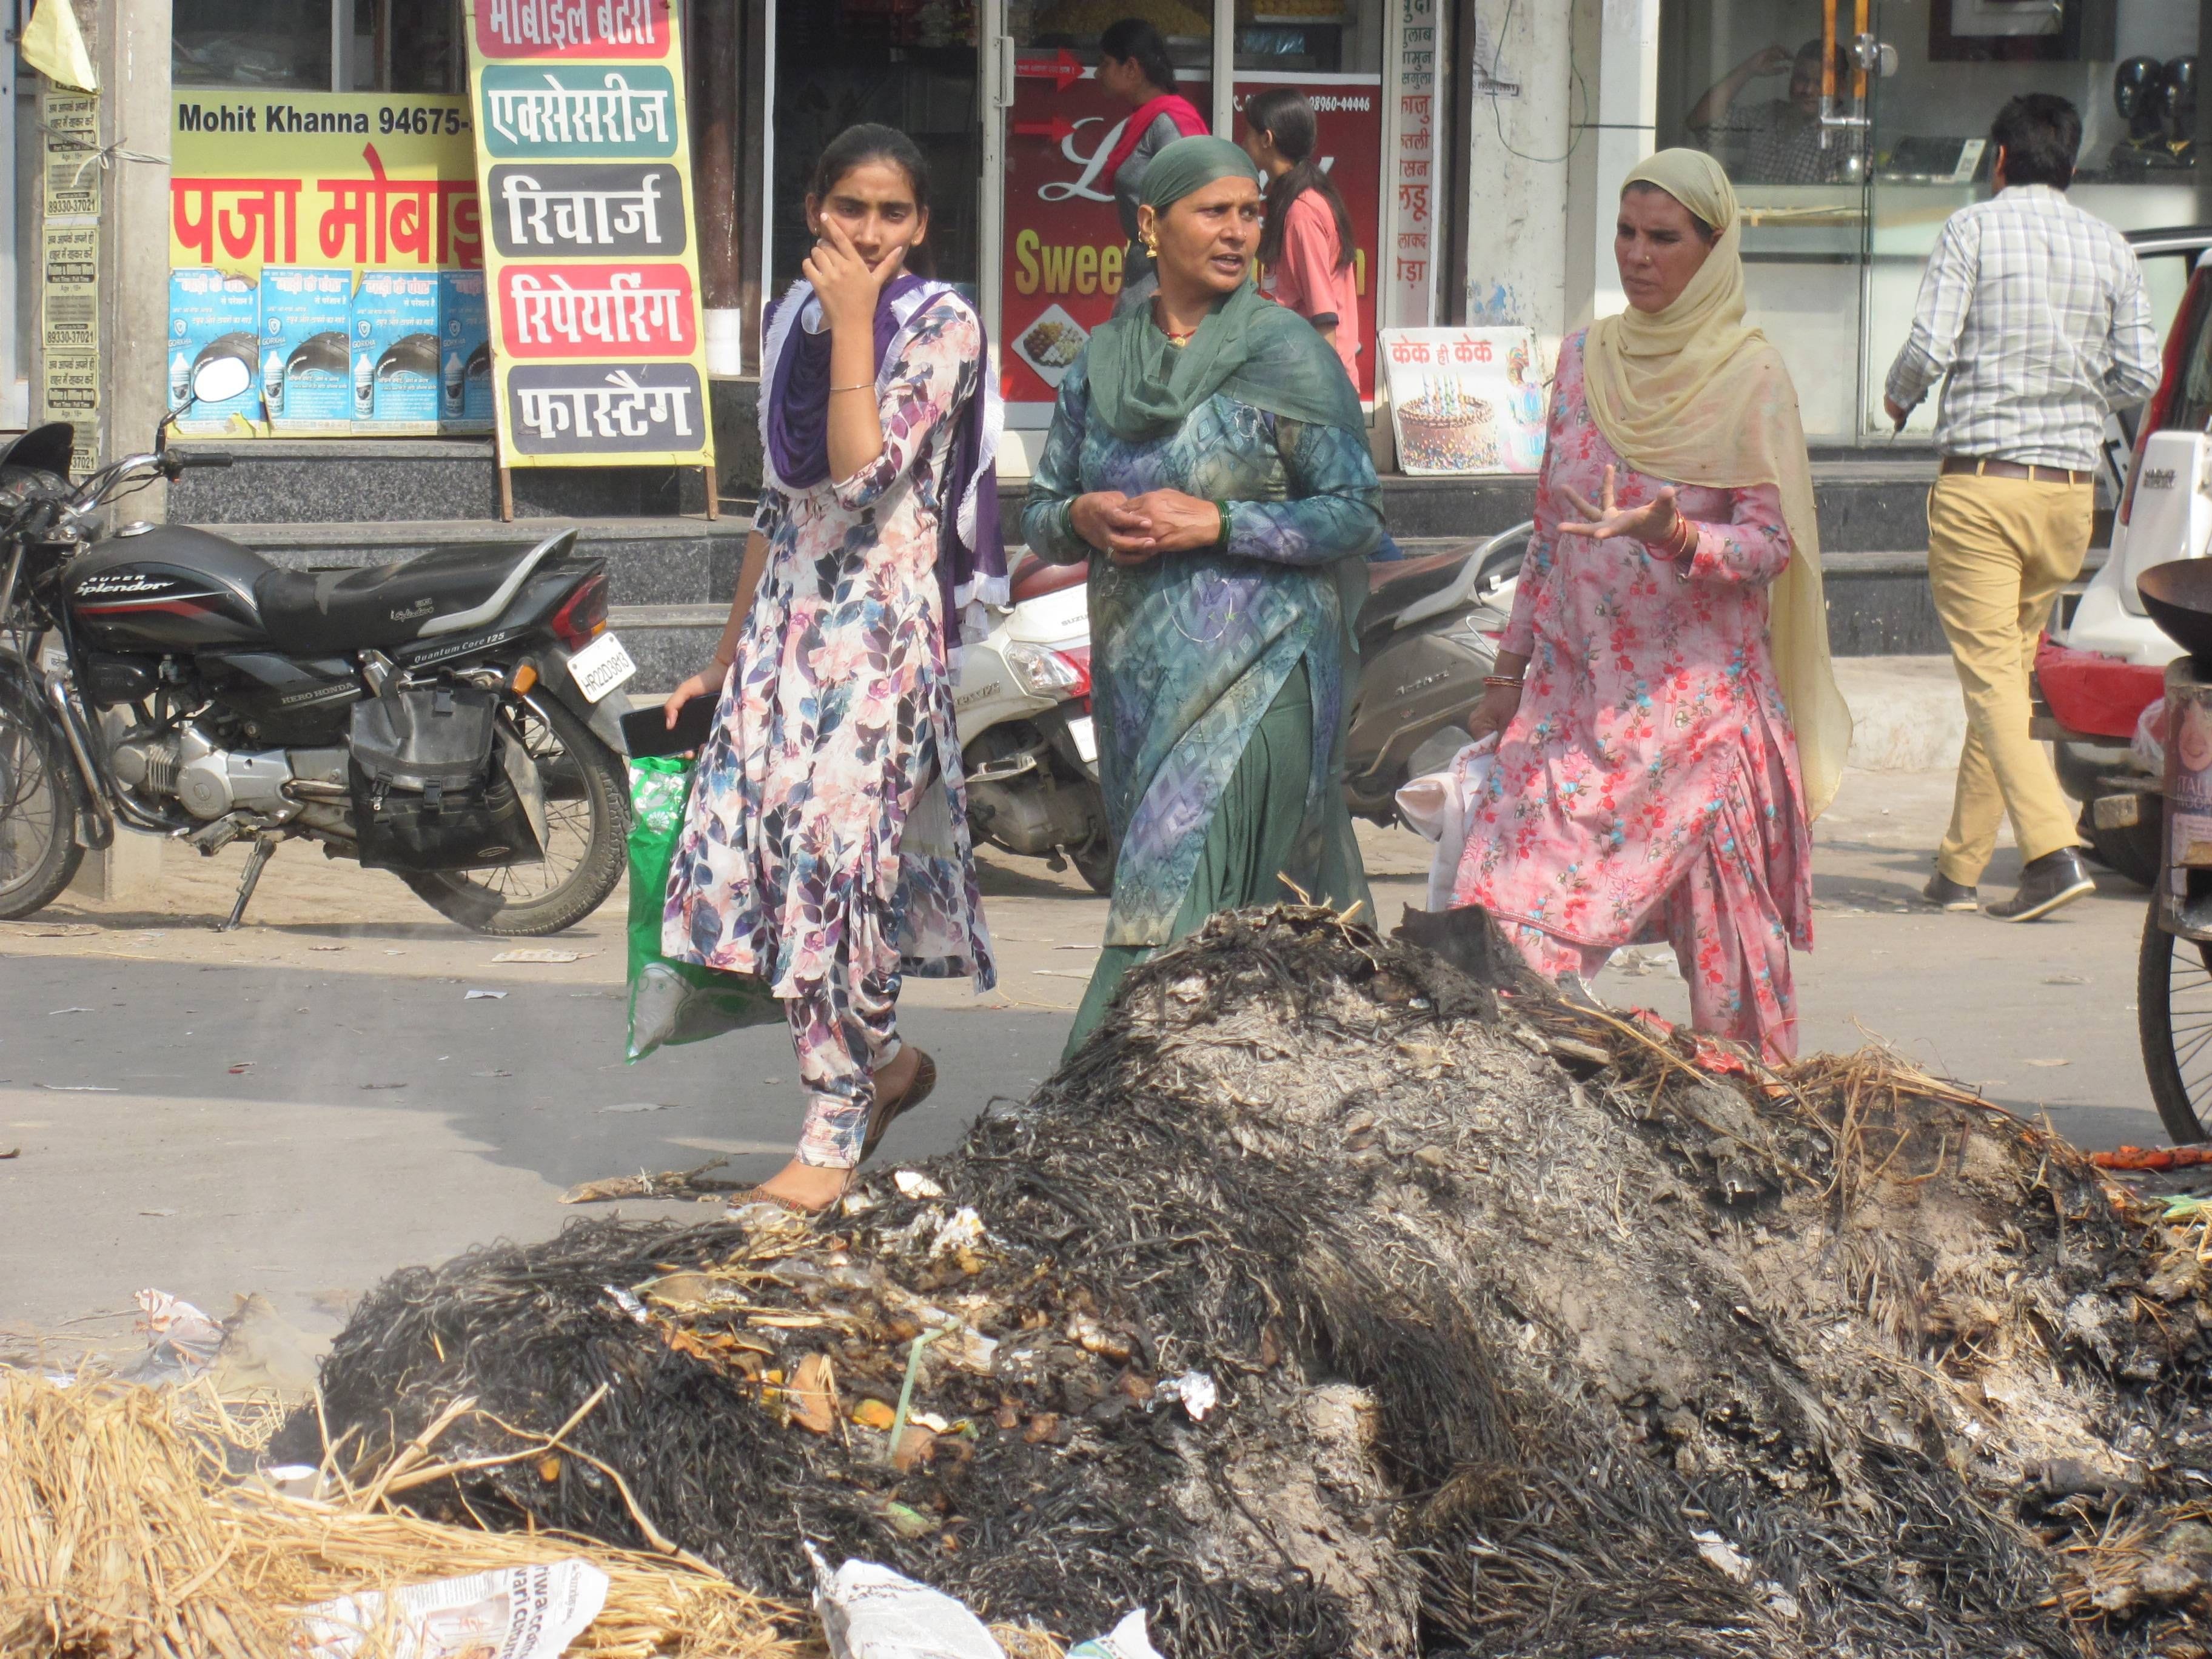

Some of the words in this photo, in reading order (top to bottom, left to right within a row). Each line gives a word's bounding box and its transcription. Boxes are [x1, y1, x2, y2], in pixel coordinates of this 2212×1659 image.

[179, 104, 256, 133] Mohit
[266, 105, 369, 133] Khanna
[378, 107, 473, 136] 94675-
[488, 73, 669, 145] एक्सेसरीज
[48, 199, 96, 213] 89330-37021
[501, 173, 662, 244] रिचार्ज
[1014, 229, 1131, 295] Swee
[510, 272, 683, 344] रिपेयरिंग
[47, 331, 93, 343] 89330-37021
[1390, 333, 1430, 364] केक
[1436, 343, 1450, 366] ही
[1453, 332, 1492, 364] केक
[517, 370, 692, 438] फास्टैग
[74, 580, 175, 597] Splendor
[414, 645, 461, 663] Quantum
[461, 638, 485, 650] Core
[486, 632, 505, 644] 125
[281, 692, 313, 705] HERO
[313, 682, 355, 697] HONDA
